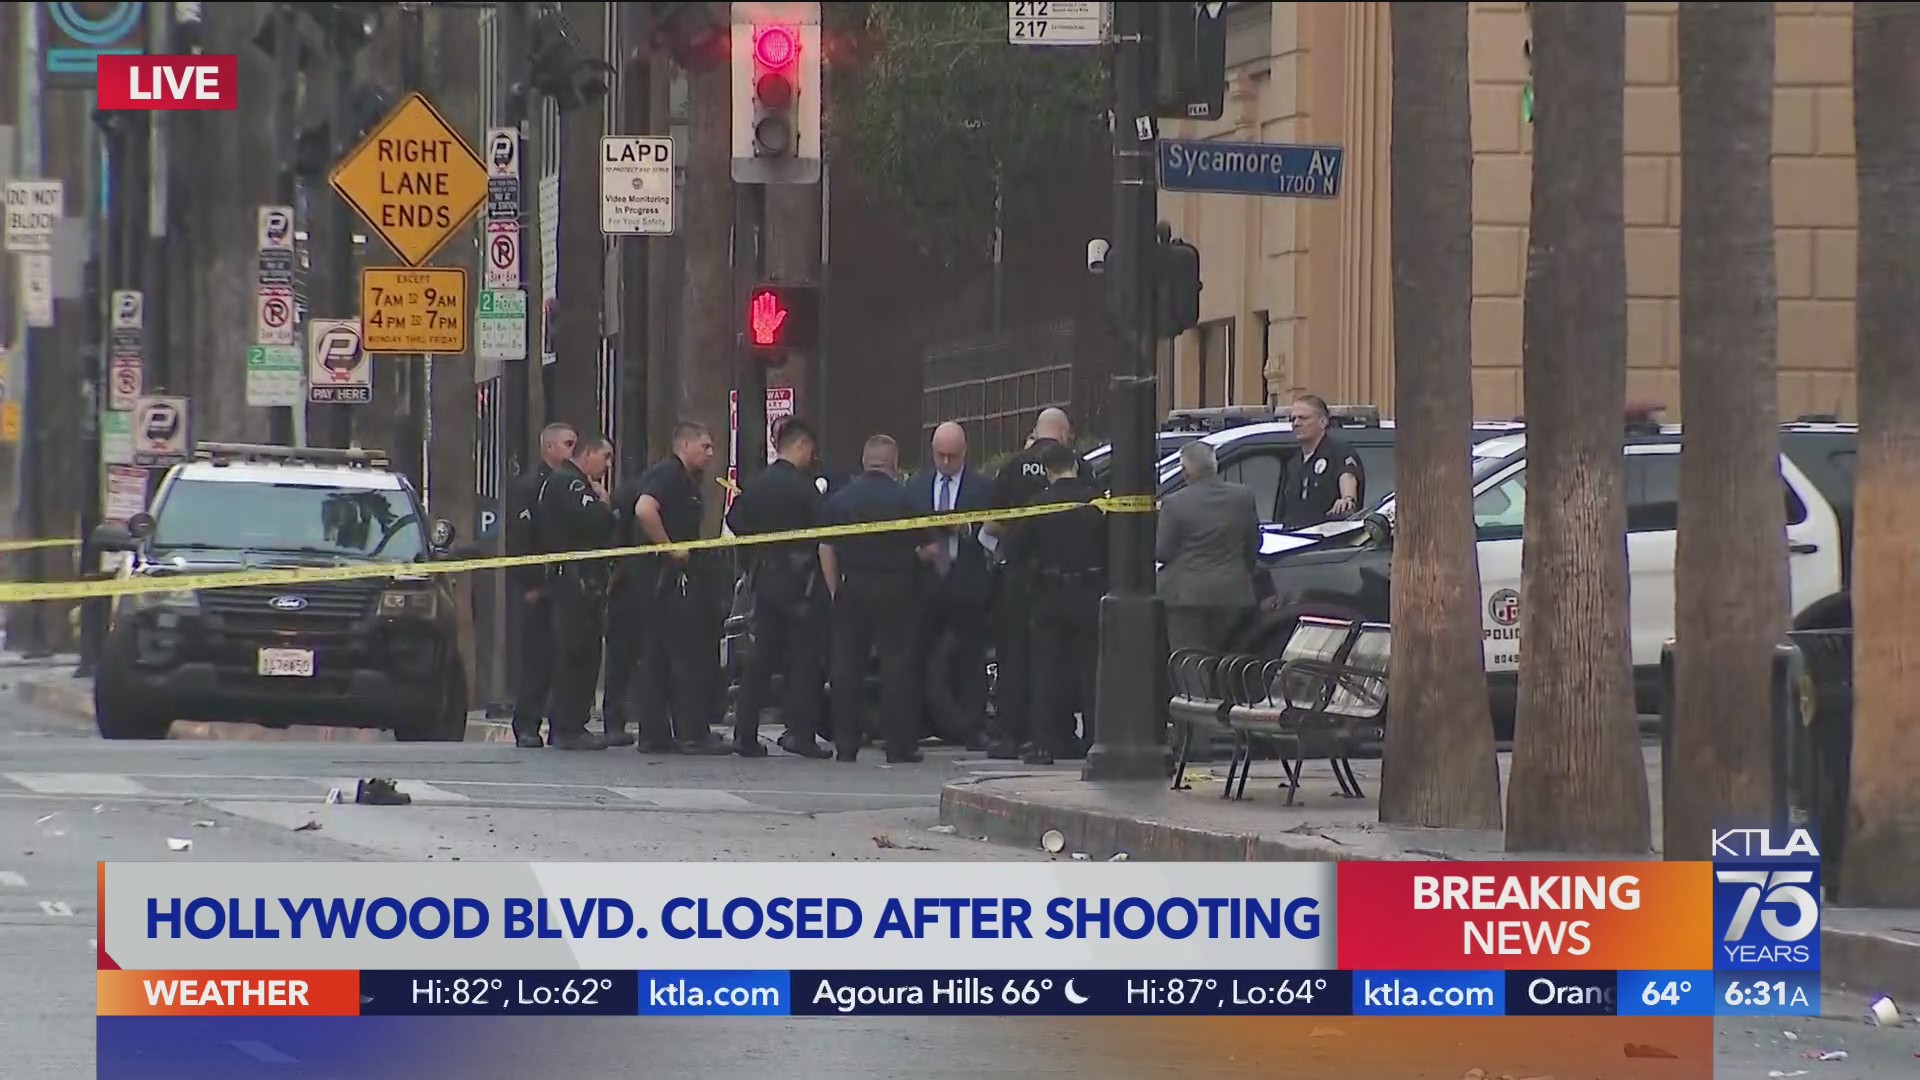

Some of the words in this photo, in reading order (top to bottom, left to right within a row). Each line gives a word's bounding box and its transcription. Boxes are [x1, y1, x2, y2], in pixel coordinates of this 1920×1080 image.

[1015, 2, 1048, 16] 212
[1015, 21, 1047, 38] 217
[378, 139, 452, 163] RIGHT
[606, 144, 668, 162] LAPD
[1169, 144, 1282, 177] Sycamore
[1308, 150, 1336, 176] Av
[381, 173, 449, 195] LANE
[1279, 175, 1315, 193] 1700
[1323, 177, 1334, 194] N
[605, 195, 627, 203] Video
[629, 195, 669, 205] Monitoring
[382, 205, 451, 228] ENDS
[625, 206, 659, 216] Progress
[642, 218, 665, 226] Safety
[397, 275, 431, 284] EXCEPT
[371, 287, 403, 307] 7AM
[424, 287, 456, 307] 9AM
[482, 293, 491, 311] 2
[370, 310, 405, 329] 4PM
[426, 310, 457, 329] 7PM
[368, 335, 402, 343] MONDAY
[429, 335, 457, 344] FRIDAY
[252, 348, 264, 364] 2
[313, 388, 334, 400] PAY
[337, 388, 367, 400] HERE
[767, 391, 785, 400] WAY
[1022, 462, 1046, 476] POL
[481, 511, 496, 532] P
[1483, 628, 1520, 640] POLIC
